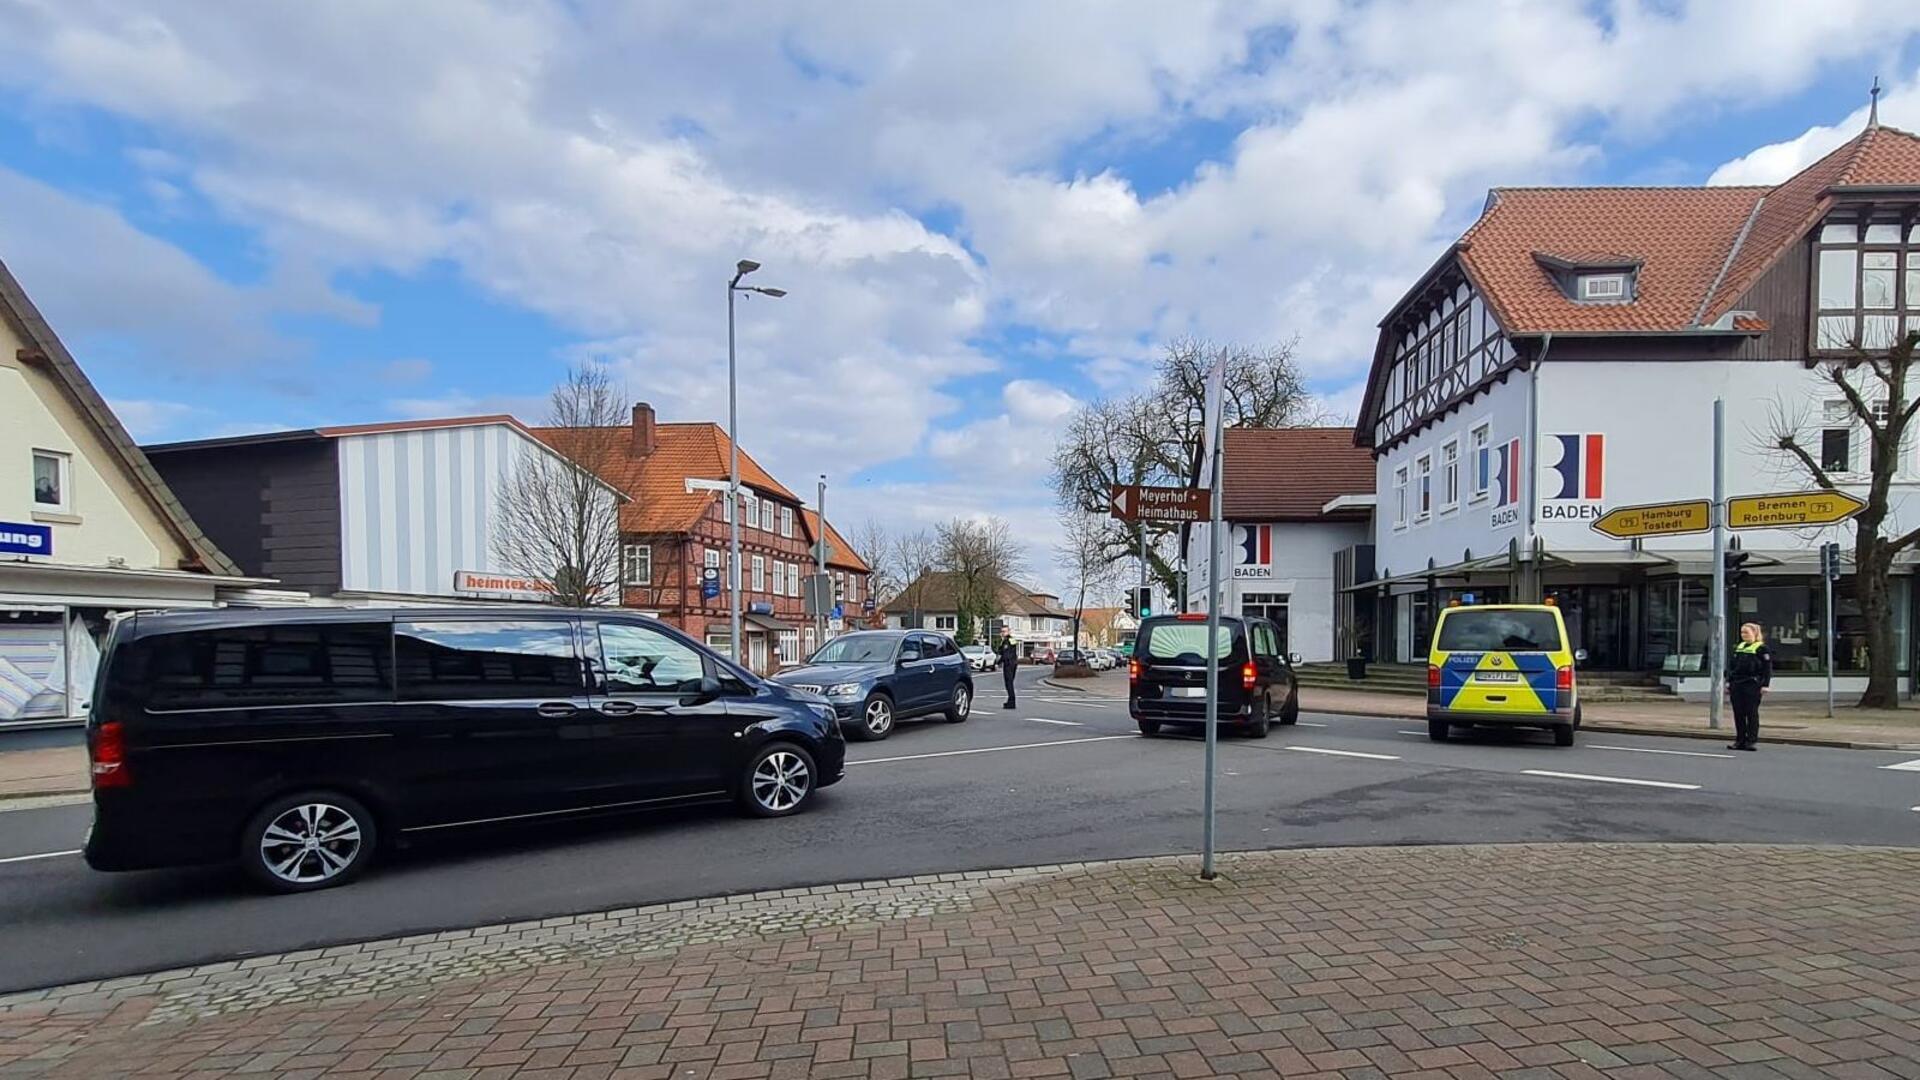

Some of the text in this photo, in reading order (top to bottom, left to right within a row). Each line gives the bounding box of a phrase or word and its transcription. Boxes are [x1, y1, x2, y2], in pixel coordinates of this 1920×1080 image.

[1140, 489, 1188, 504] Meyerhof
[1758, 500, 1806, 510] Bremen
[1137, 504, 1199, 519] Heimathaus
[1542, 505, 1602, 518] BADEN
[1641, 509, 1692, 519] Hamburg
[1491, 509, 1518, 527] BADEN
[1743, 512, 1806, 522] Rotenburg
[1644, 520, 1682, 530] Tostedt
[1234, 568, 1271, 577] BADEN
[1449, 656, 1478, 664] POLIZEI
